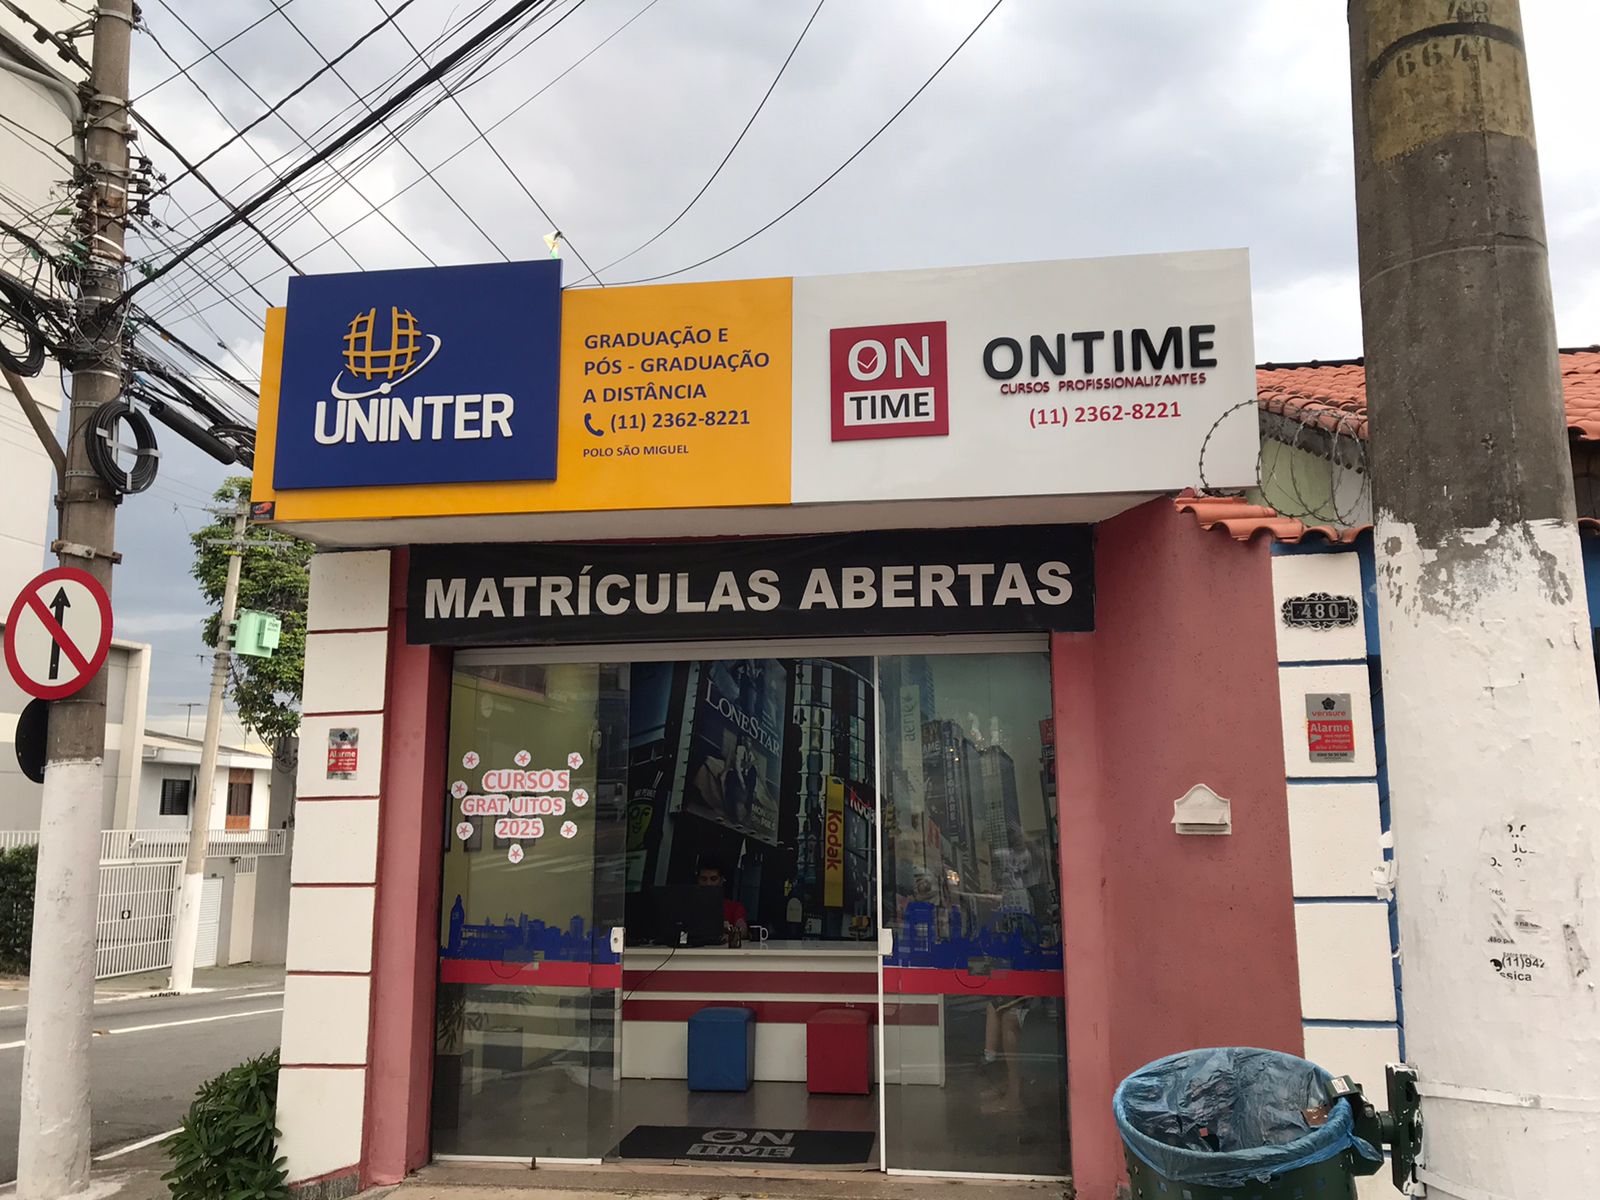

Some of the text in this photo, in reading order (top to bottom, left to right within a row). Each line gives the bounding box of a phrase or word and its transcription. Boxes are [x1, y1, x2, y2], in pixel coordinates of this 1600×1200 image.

[584, 326, 728, 349] GRADUAÇÃO E
[584, 357, 622, 375] PÓS
[641, 350, 770, 372] GRADUAÇÃO
[848, 335, 930, 381] ON
[983, 324, 1217, 380] ONTIME
[583, 382, 707, 403] A DISTÂNCIA
[1000, 372, 1207, 395] CURSOS PROFISSIONALIZANTES
[849, 392, 930, 421] TIME
[1029, 401, 1182, 428] (11) 2362-8221
[314, 393, 515, 445] UNINTER
[610, 410, 750, 433] (11) 2362-8221
[583, 445, 689, 457] POLO SÃO MIGUEL
[424, 560, 1073, 619] MATRÍCULAS ABERTAS
[1301, 603, 1339, 619] 480
[1311, 723, 1350, 732] Alarme
[483, 771, 568, 790] CURSOS
[463, 798, 563, 813] GRATUITOS
[498, 820, 541, 836] 2025
[827, 809, 843, 870] Kodak
[702, 1130, 794, 1145] ON
[699, 1146, 788, 1156] TIME
